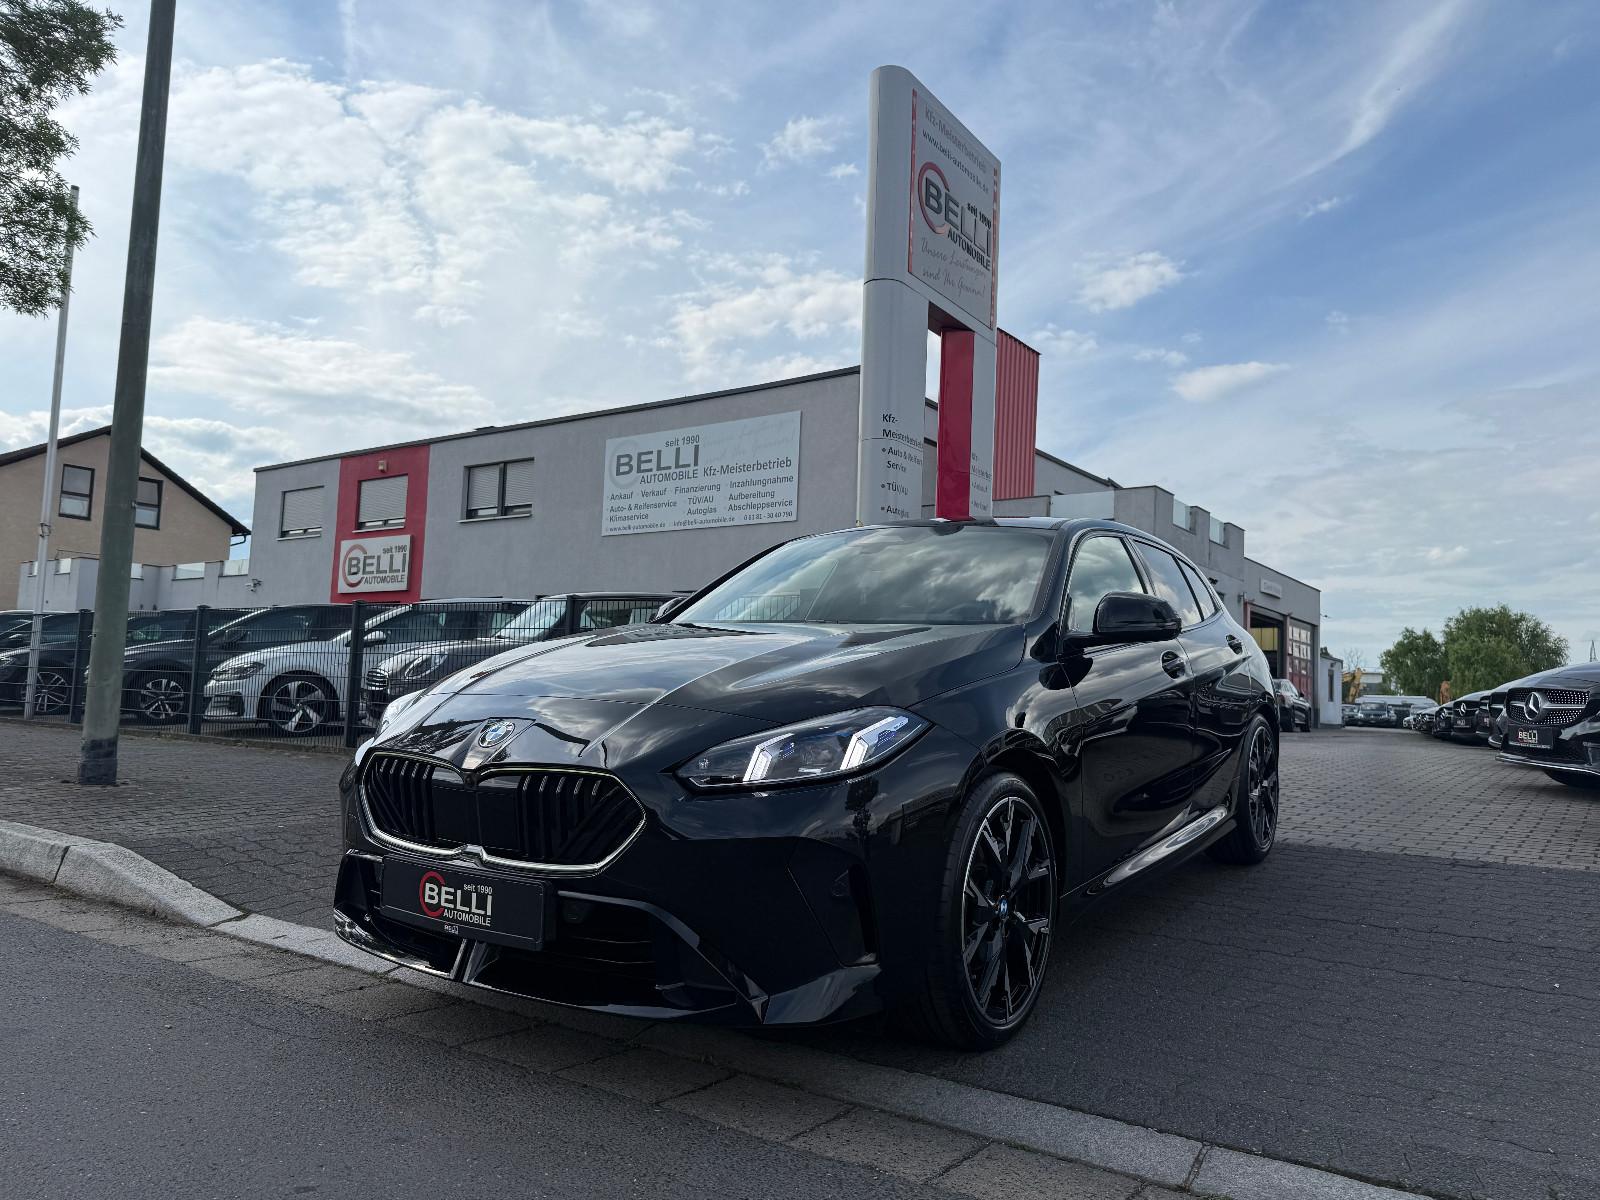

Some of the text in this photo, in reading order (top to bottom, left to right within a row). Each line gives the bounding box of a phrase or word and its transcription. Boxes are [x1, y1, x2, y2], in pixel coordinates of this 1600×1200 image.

[925, 177, 991, 257] BELLI
[967, 202, 992, 230] seit 1990
[948, 228, 991, 272] AUTOMOBILE
[882, 413, 899, 424] Kfz-
[665, 435, 700, 448] seit 1990
[615, 444, 700, 477] BELLI
[703, 456, 792, 478] Kfz-Meisterbetrieb
[639, 468, 699, 485] AUTOMOBILE
[610, 475, 794, 502] Ankauf Verkauf Finanzierung Inzahlungnahme
[609, 490, 776, 514] Auto- & Reifenservice TÜV/AU Aufbereitung
[609, 499, 793, 523] Klimaservice Autoglas Abschleppservice
[382, 544, 408, 554] seit 1990
[347, 553, 407, 576] BELLI
[363, 575, 405, 585] AUTOMOBILE
[424, 882, 493, 916] BELLI
[463, 883, 493, 895] seit 1990
[443, 908, 491, 927] AUTOMOBILE
